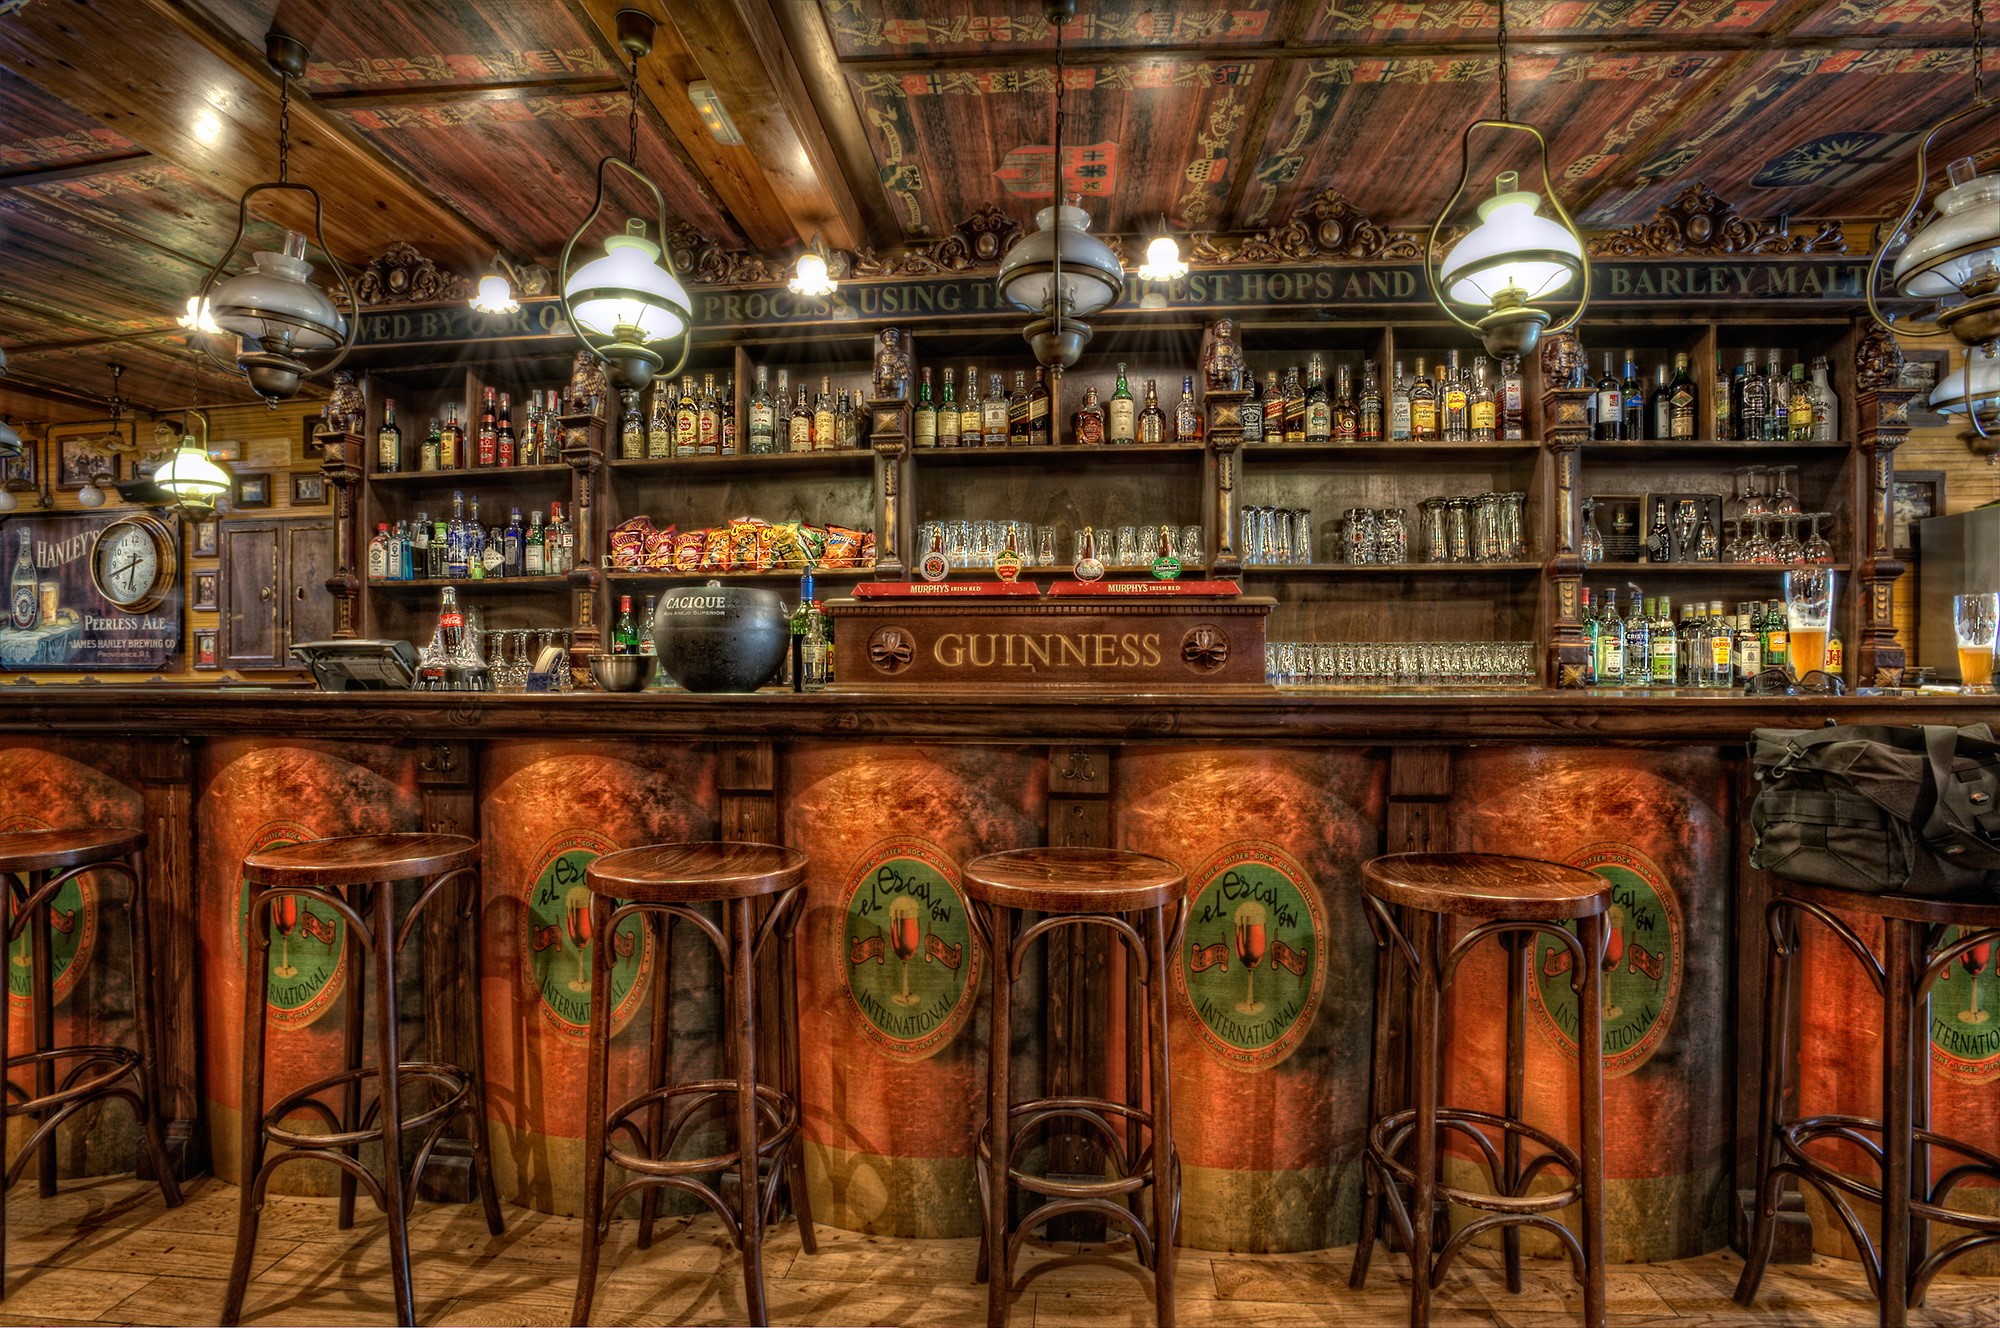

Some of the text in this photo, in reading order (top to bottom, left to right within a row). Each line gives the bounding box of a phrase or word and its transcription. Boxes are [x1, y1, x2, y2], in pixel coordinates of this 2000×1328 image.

[1240, 270, 1334, 300] HOPS
[1341, 269, 1418, 298] AND
[1608, 264, 1754, 297] BARLEY
[1767, 263, 1870, 297] MALT
[703, 285, 850, 322] PROCESS
[858, 284, 963, 316] USING
[420, 311, 460, 337] BY
[1343, 420, 1353, 428] 43
[36, 529, 100, 568] HANLEY'S
[121, 539, 128, 547] 11
[131, 535, 139, 544] 12
[830, 532, 858, 547] Doritos
[114, 548, 122, 557] 10
[910, 584, 949, 593] MURPHY'S
[1107, 583, 1148, 593] MURPHY'S
[666, 596, 726, 610] CACIQUE
[84, 614, 167, 631] PEERLESS ALE
[71, 639, 176, 649] JAMES HANLEY BREWING CO
[933, 633, 1161, 668] GUINNESS
[581, 840, 599, 849] BOCK
[879, 848, 902, 860] BITTER
[907, 848, 926, 858] BOCK
[930, 857, 948, 872] DARK
[1224, 852, 1250, 865] BITTER
[1254, 852, 1274, 863] BOCK
[1278, 861, 1296, 878] DARK
[1580, 855, 1607, 868] BITTER
[1611, 855, 1632, 866] BOCK
[1636, 863, 1653, 880] DARK
[270, 966, 329, 1005] RNATIONAL
[541, 976, 627, 1021] INTERNATAL
[859, 989, 954, 1036] INTERNATIONAL
[1199, 998, 1299, 1045] INTERNATIONAL
[566, 1027, 587, 1037] LAGER
[1554, 1003, 1656, 1050] INTATIONAL
[1932, 1018, 2000, 1055] TERNATIO
[889, 1042, 911, 1052] LAGER
[915, 1029, 946, 1051] PILSENER
[1201, 1030, 1228, 1055] EXPORT
[1231, 1052, 1255, 1062] LAGER
[1258, 1038, 1291, 1061] PILSENER
[1556, 1036, 1579, 1058] EXPOR
[1616, 1044, 1648, 1068] PILSENER
[1954, 1062, 1979, 1073] LAGER
